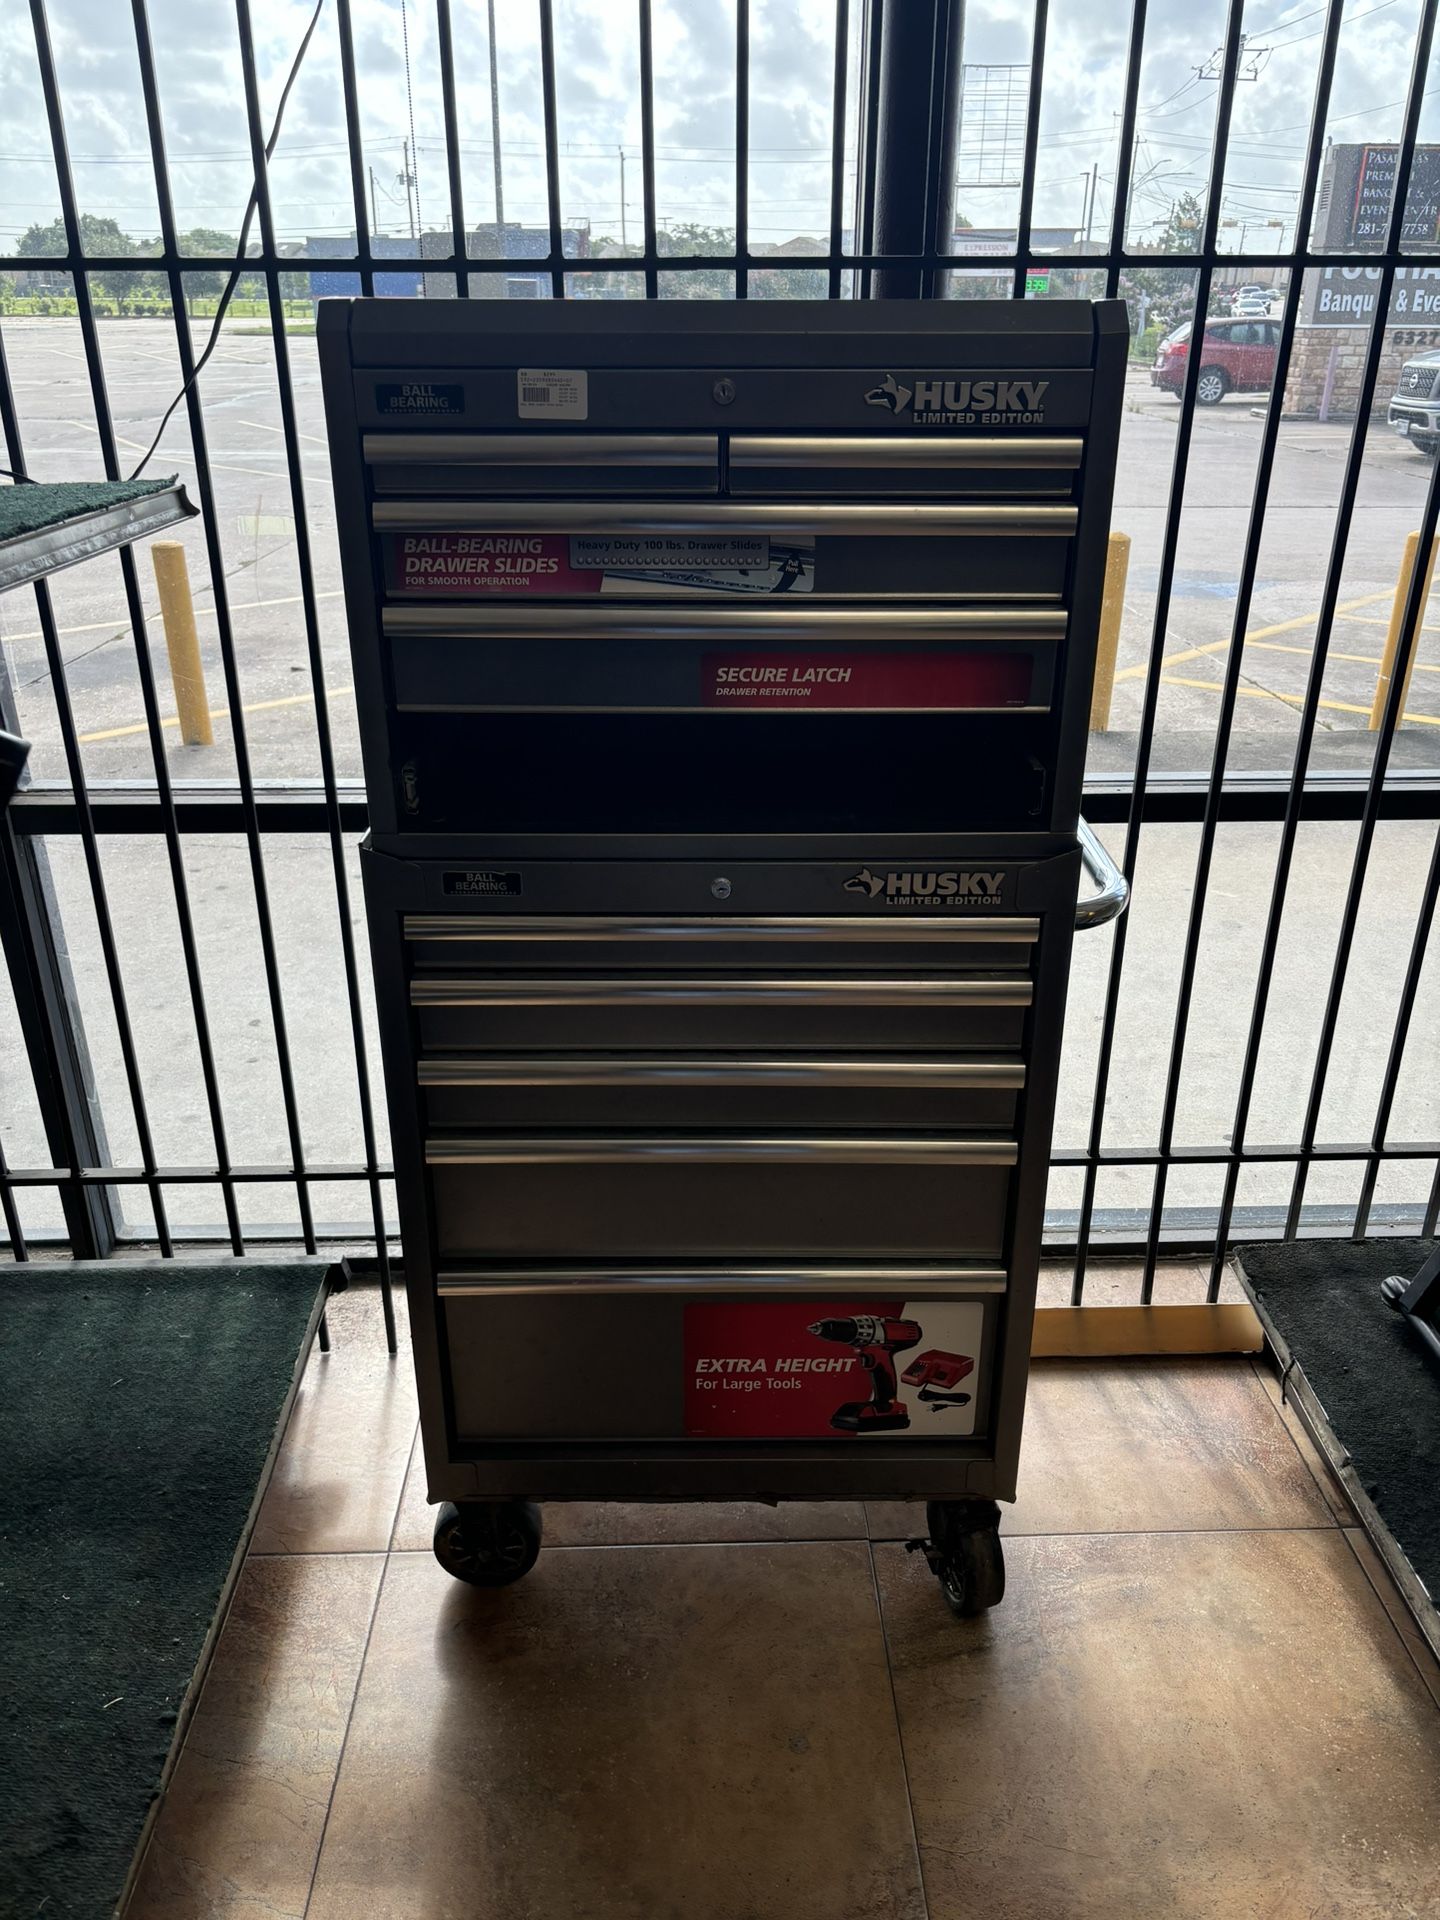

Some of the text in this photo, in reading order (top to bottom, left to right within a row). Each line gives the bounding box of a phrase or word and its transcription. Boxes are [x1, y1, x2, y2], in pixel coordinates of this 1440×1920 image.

[1357, 223, 1429, 235] 281-7-7758
[1319, 288, 1391, 318] Banqu
[1396, 288, 1408, 313] &
[402, 385, 435, 396] BALL
[913, 381, 1049, 411] HUSKY
[390, 397, 448, 408] BEARING
[913, 412, 1044, 424] LIMITED EDITION
[404, 538, 543, 554] BALL-BEARING
[577, 540, 762, 552] Heavy Duty 100 lbs. Drawer Slides
[405, 557, 559, 574] DRAWER SLIDES
[405, 576, 530, 586] FOR SMOOTH OPERATION
[716, 667, 852, 683] SECURE LATCH
[715, 687, 811, 696] DRAWER RETENTION
[466, 873, 495, 882] BALL
[886, 871, 1006, 896] HUSKY
[455, 882, 507, 891] BEARING
[886, 896, 1002, 905] LIMITED EDITION
[695, 1357, 857, 1373] EXTRA HEIGHT
[695, 1378, 802, 1393] For Large Tools
